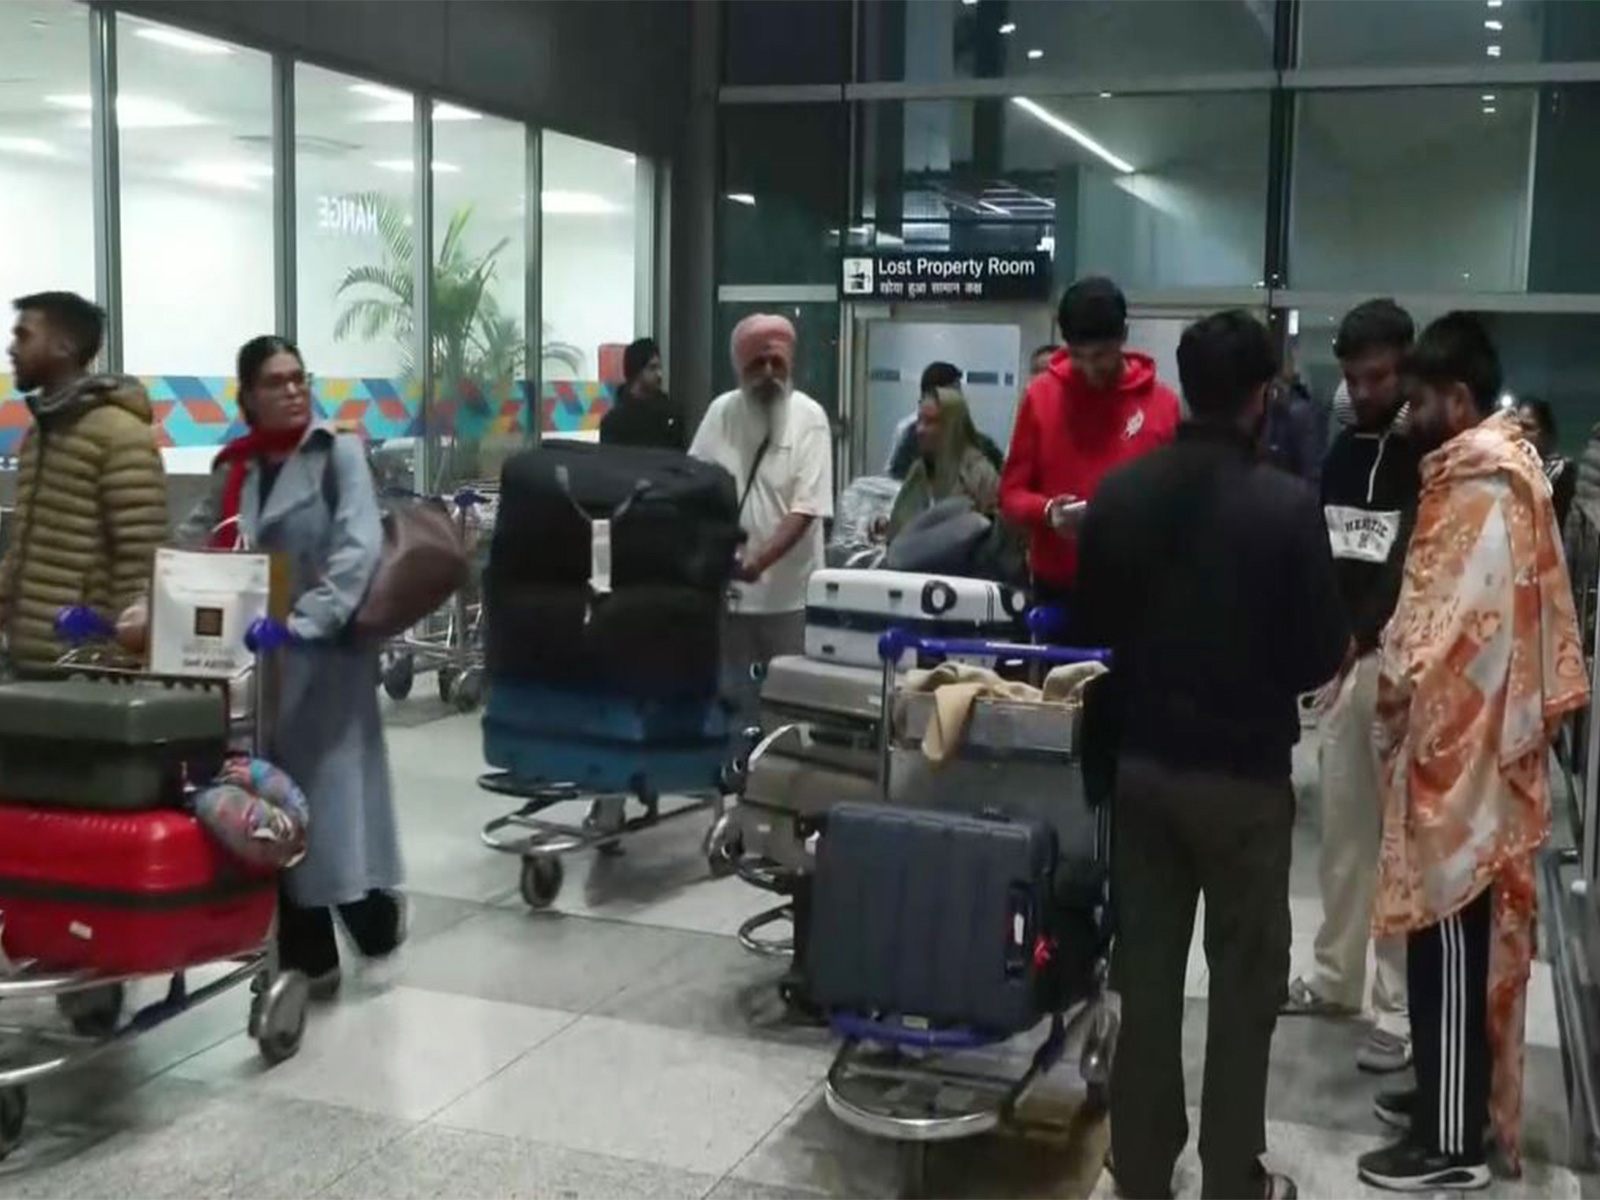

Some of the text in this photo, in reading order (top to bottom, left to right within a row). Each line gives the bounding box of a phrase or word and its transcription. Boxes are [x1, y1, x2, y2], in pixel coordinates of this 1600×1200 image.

[878, 257, 1035, 278] Lost Property Room
[908, 282, 926, 298] हुआ
[931, 282, 960, 294] सामान
